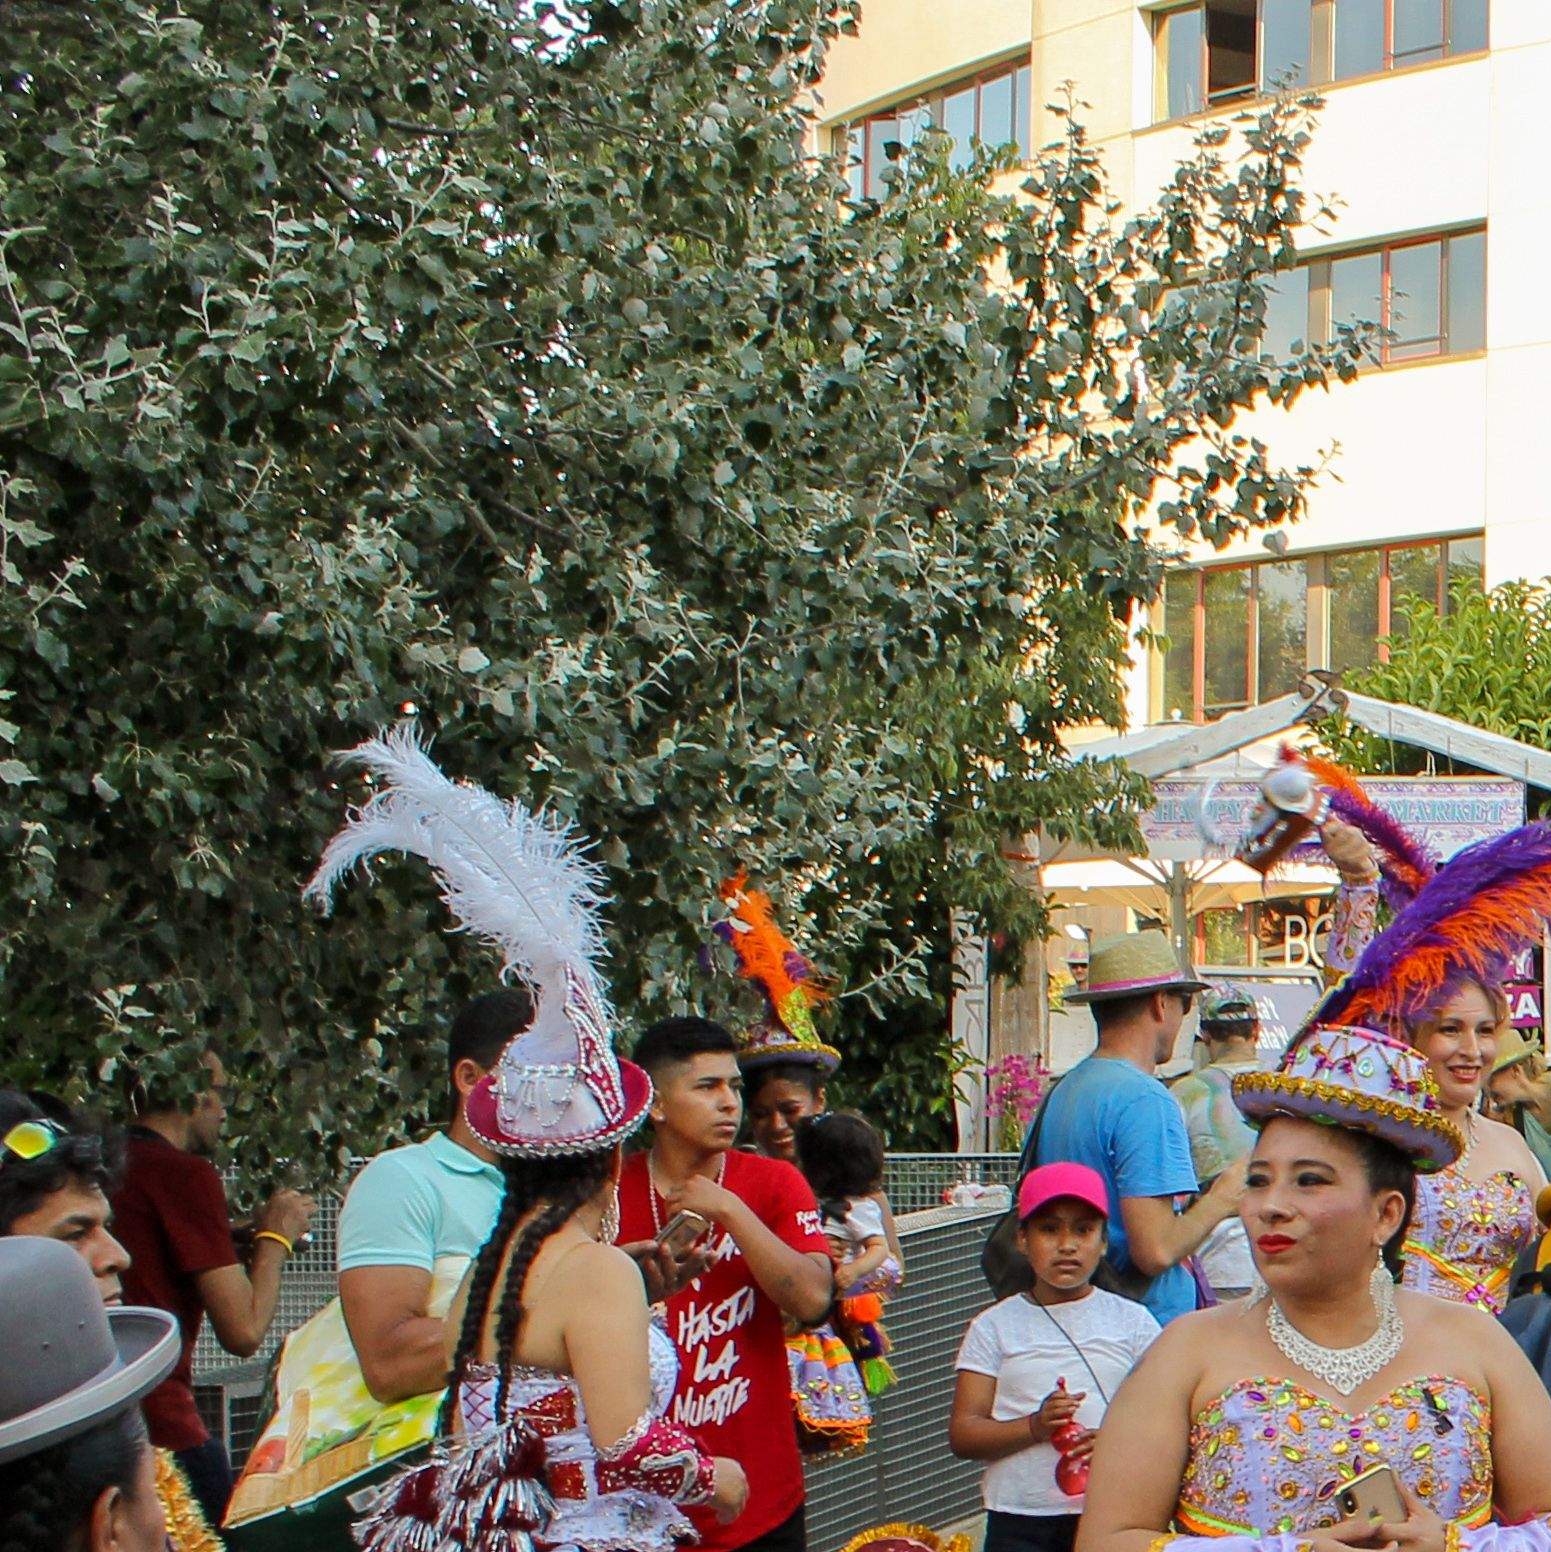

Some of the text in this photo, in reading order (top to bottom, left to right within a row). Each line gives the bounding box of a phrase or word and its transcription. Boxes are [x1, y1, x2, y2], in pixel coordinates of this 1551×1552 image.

[1388, 798, 1504, 824] MARKET
[679, 1285, 755, 1353] HASTA
[694, 1339, 740, 1383] LA
[674, 1376, 751, 1428] MUERTE
